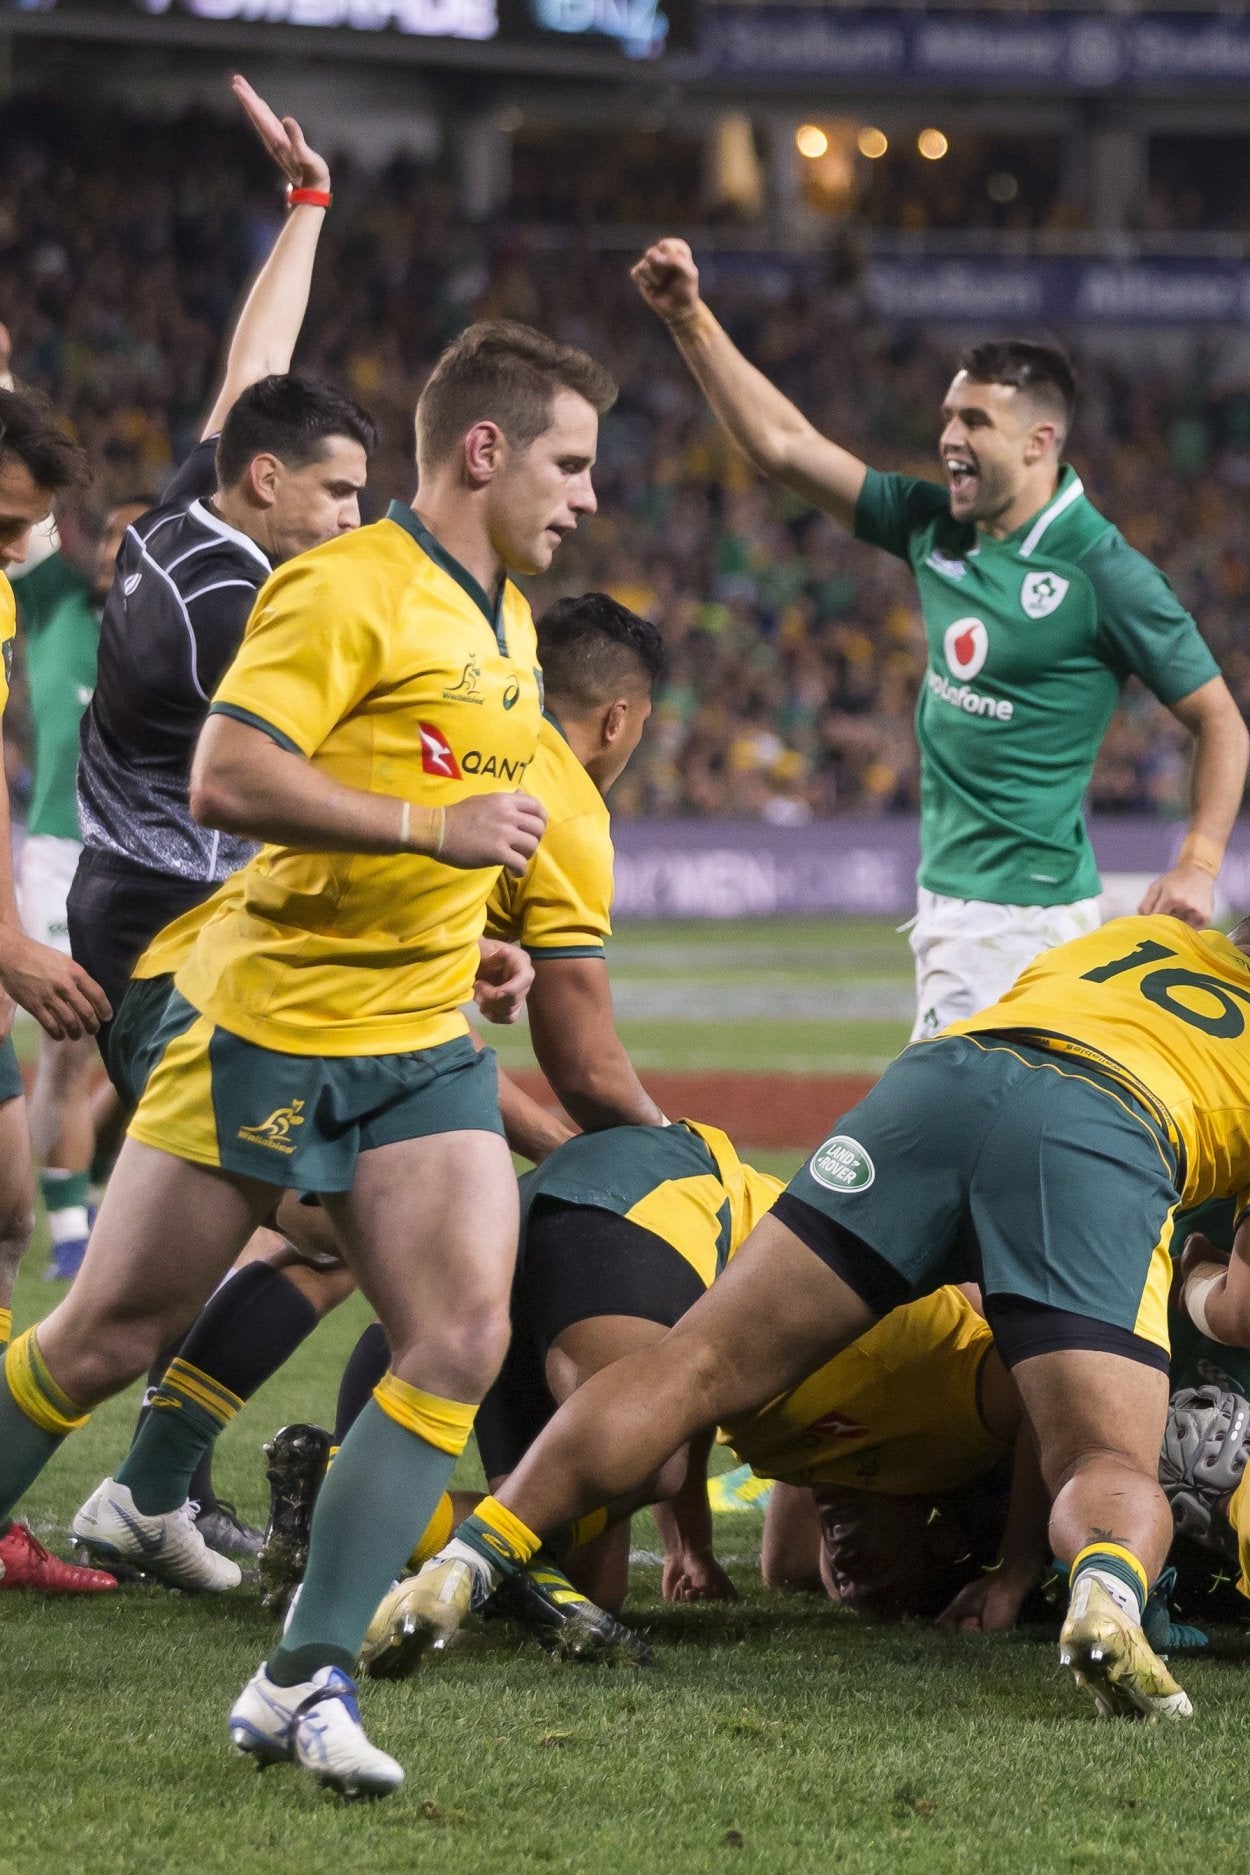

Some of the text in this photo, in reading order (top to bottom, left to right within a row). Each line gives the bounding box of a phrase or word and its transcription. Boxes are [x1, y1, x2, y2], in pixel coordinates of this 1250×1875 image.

[461, 750, 535, 785] QANT
[826, 1144, 856, 1165] LAND
[819, 1156, 857, 1184] ROVER
